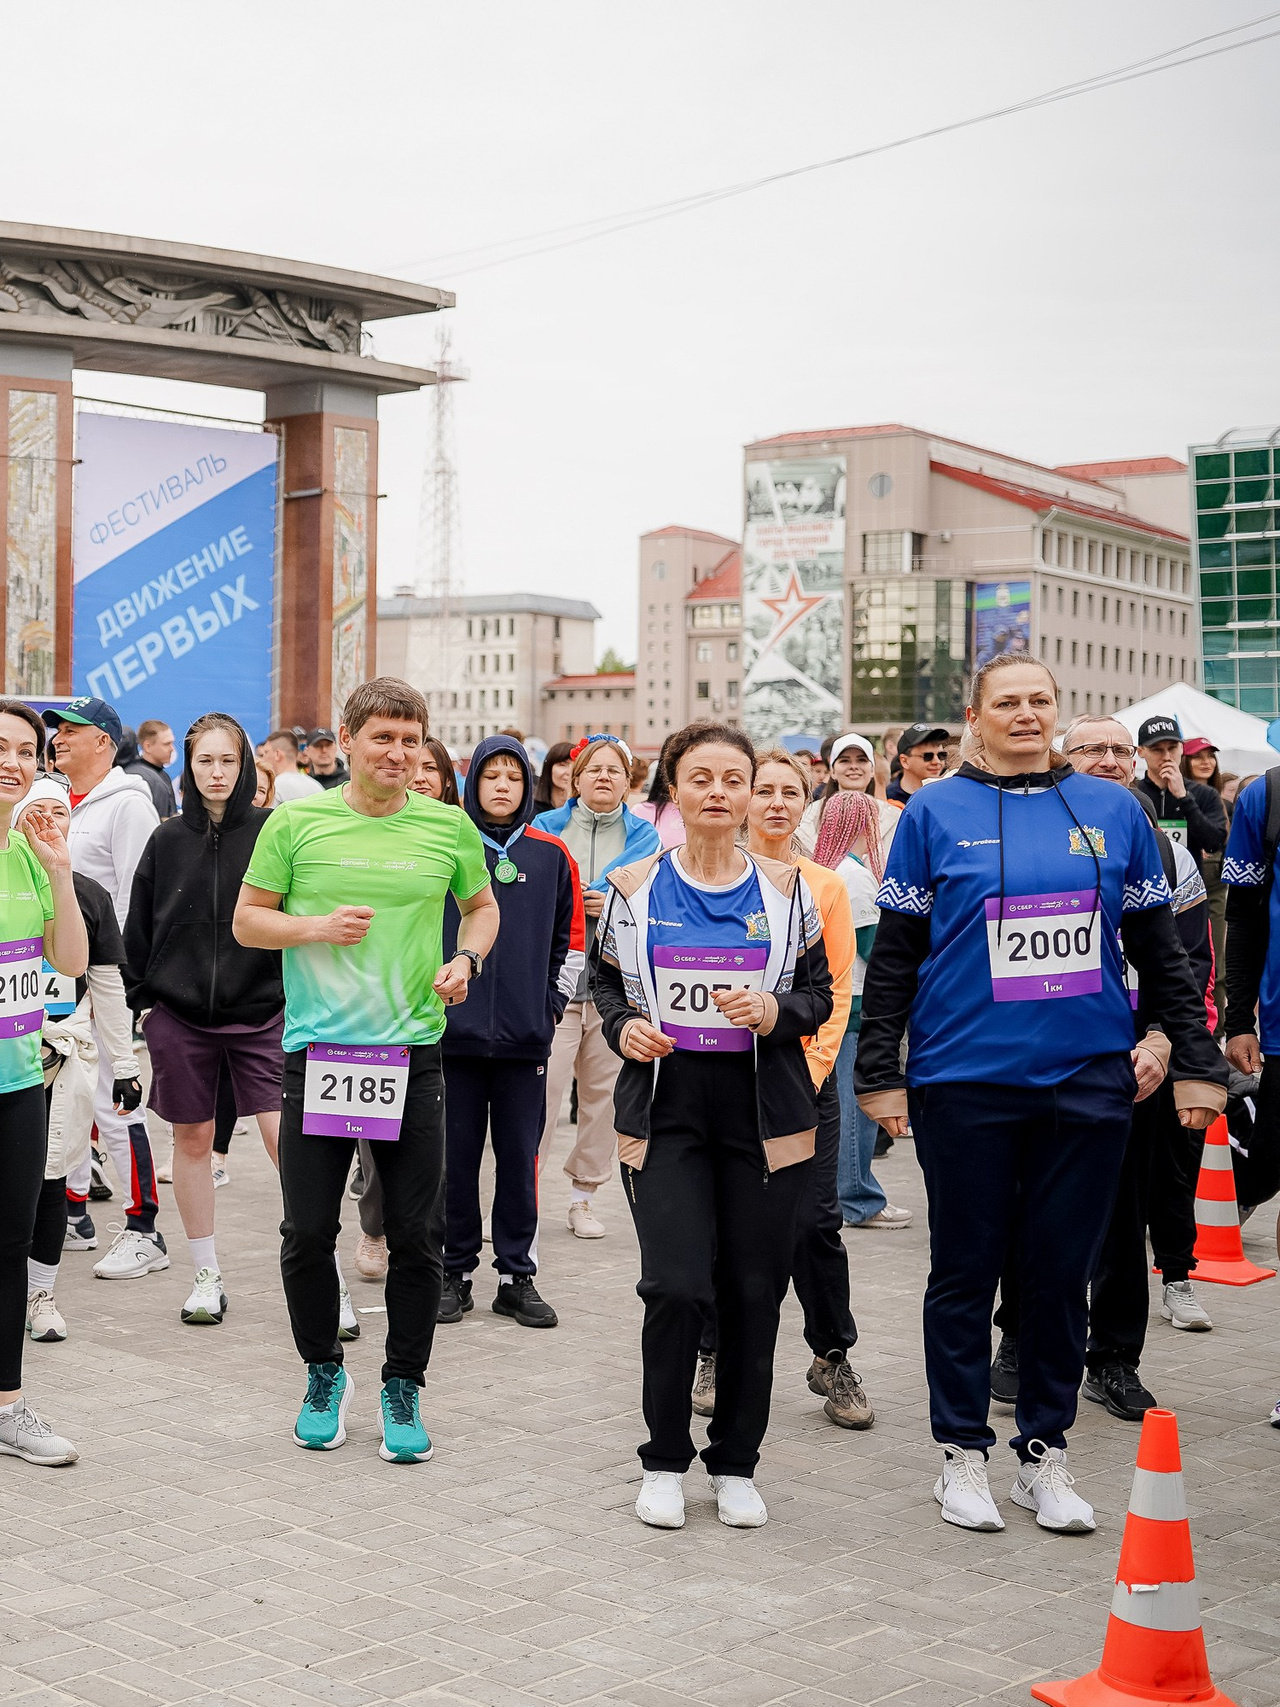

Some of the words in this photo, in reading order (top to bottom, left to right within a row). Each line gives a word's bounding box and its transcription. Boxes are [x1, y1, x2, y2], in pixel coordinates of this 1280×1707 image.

[89, 452, 228, 546] ФЕСТИВАЛЬ
[95, 525, 254, 649] ДВИЖЕНИЕ
[84, 573, 261, 700] ПЕРВЫХ
[1007, 926, 1092, 962] 2000
[320, 1073, 397, 1106] 2185
